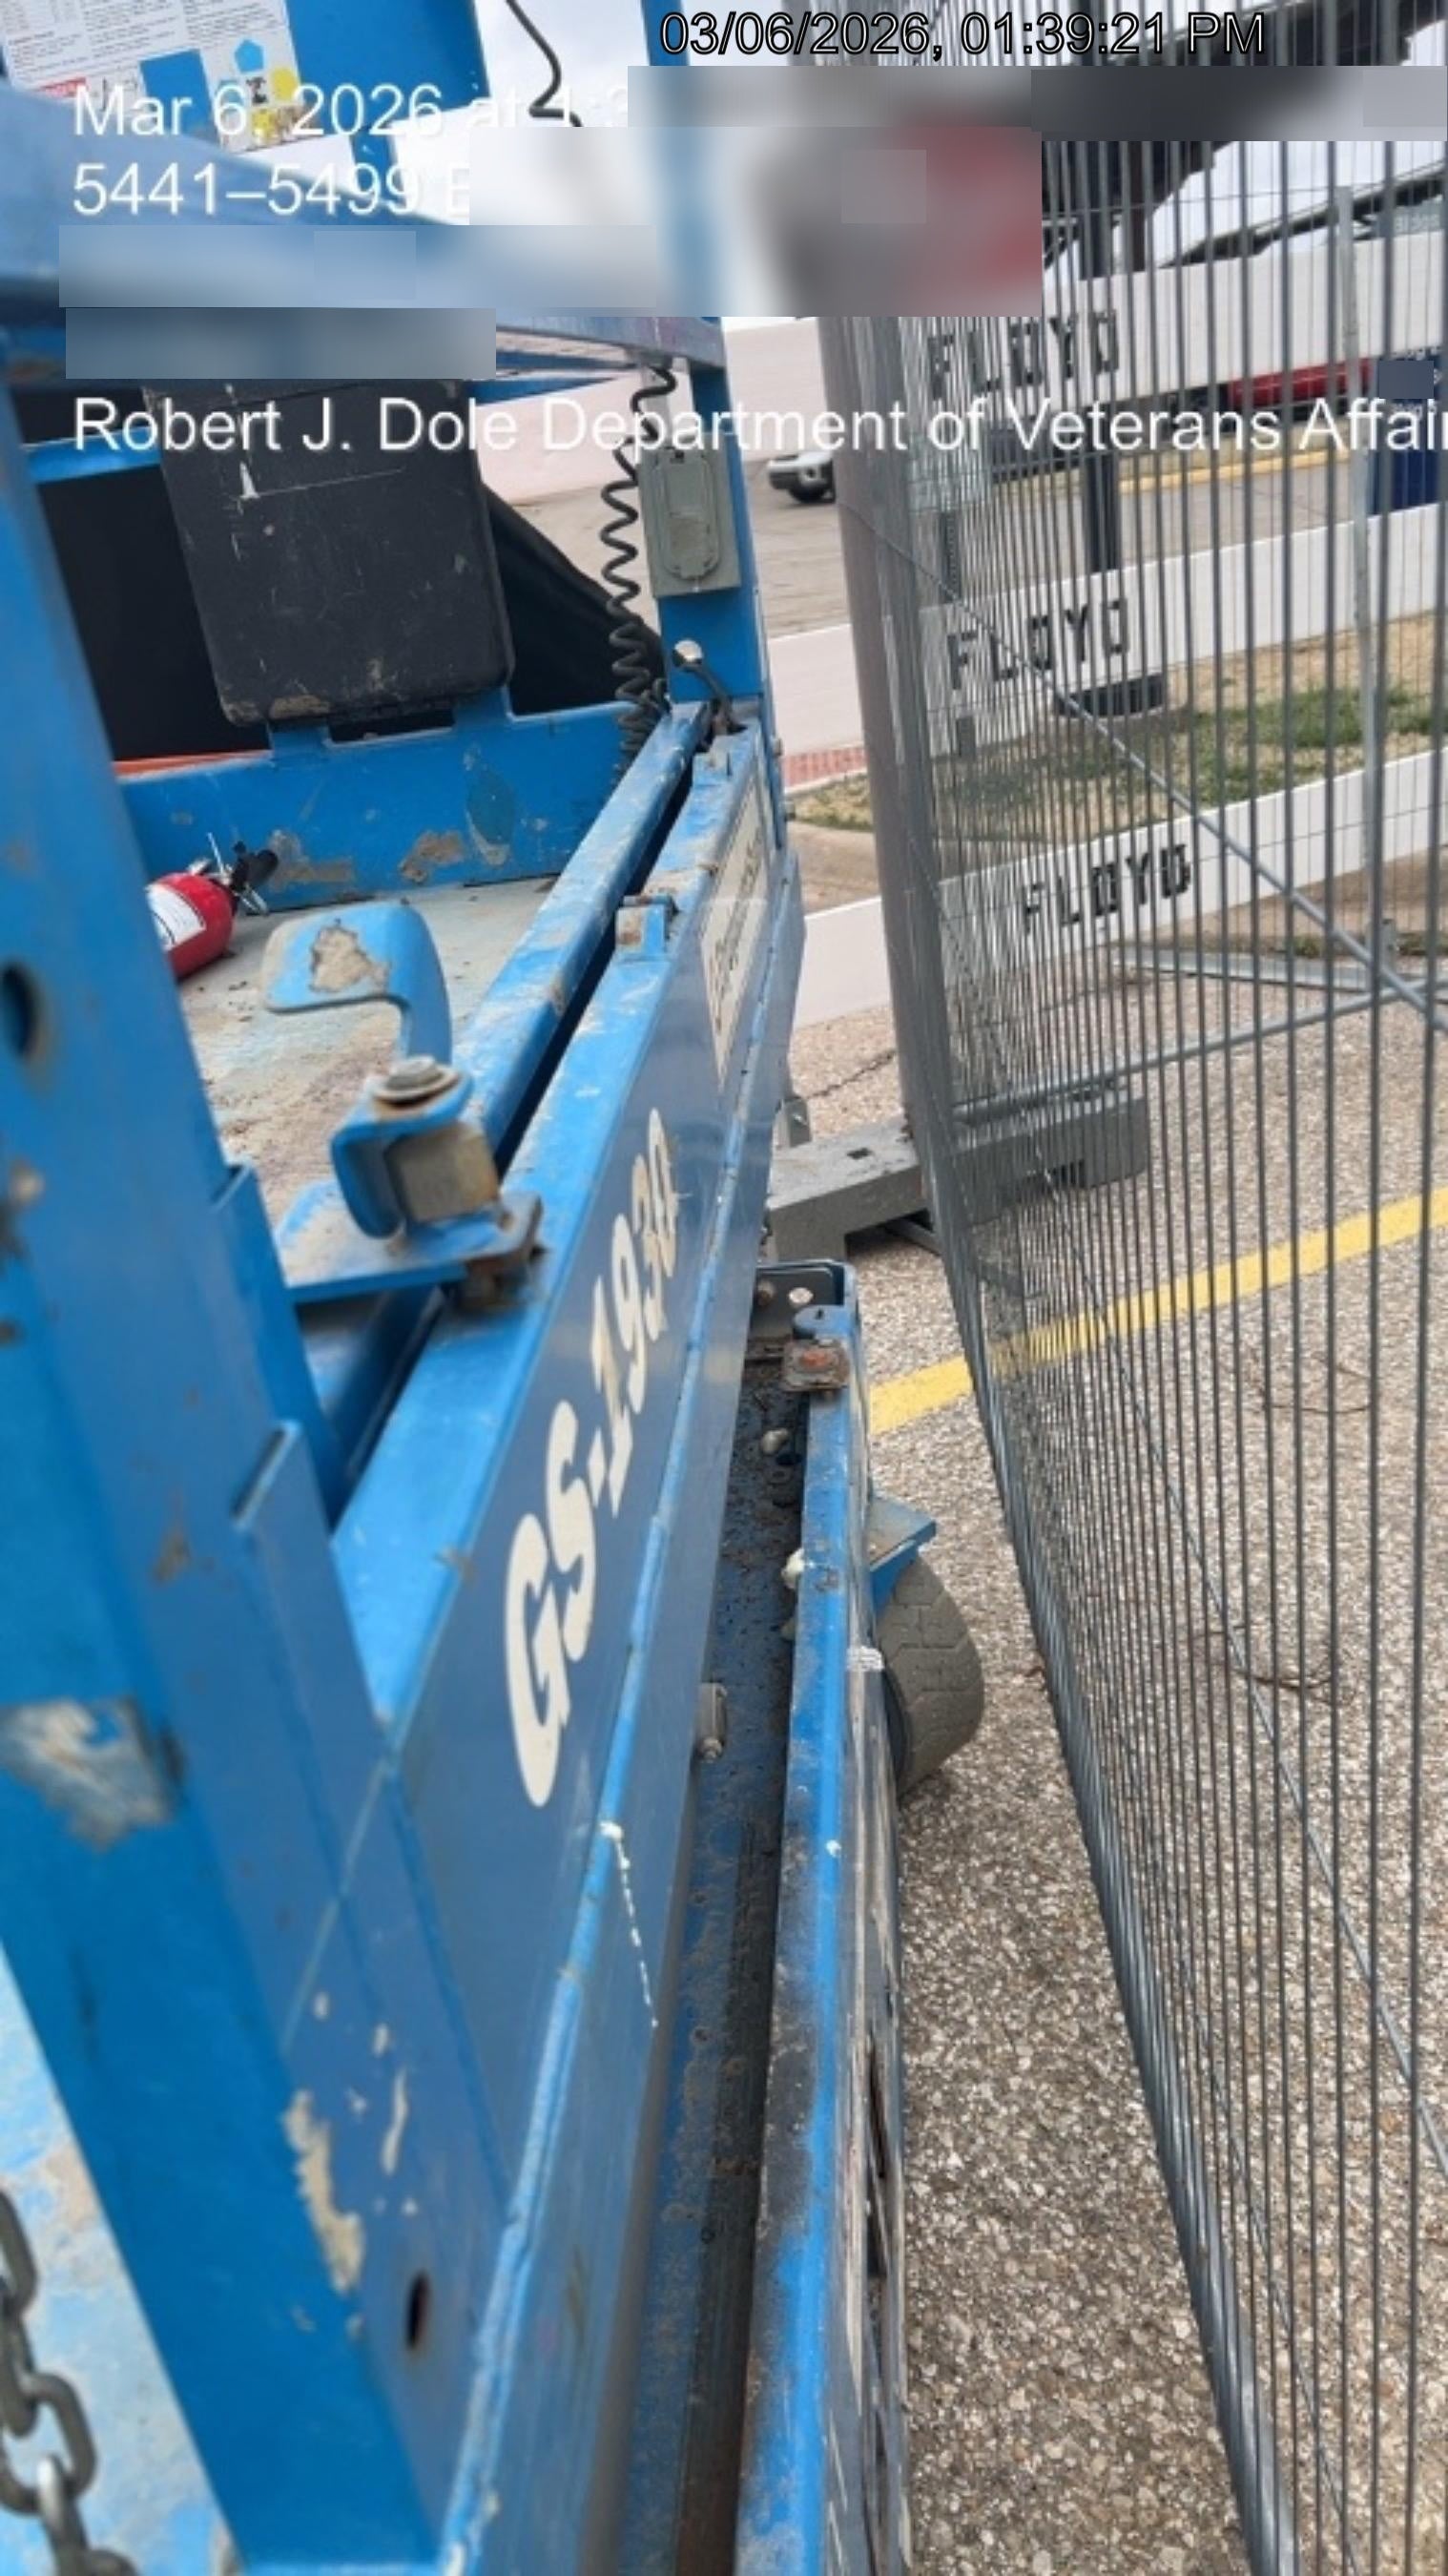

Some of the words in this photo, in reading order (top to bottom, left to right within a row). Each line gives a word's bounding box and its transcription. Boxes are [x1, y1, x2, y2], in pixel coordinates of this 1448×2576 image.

[927, 307, 1120, 401] FLOYD
[946, 599, 1129, 690] FLOYD
[1023, 843, 1190, 935] FLOYD
[506, 1108, 679, 1807] GS-1930
